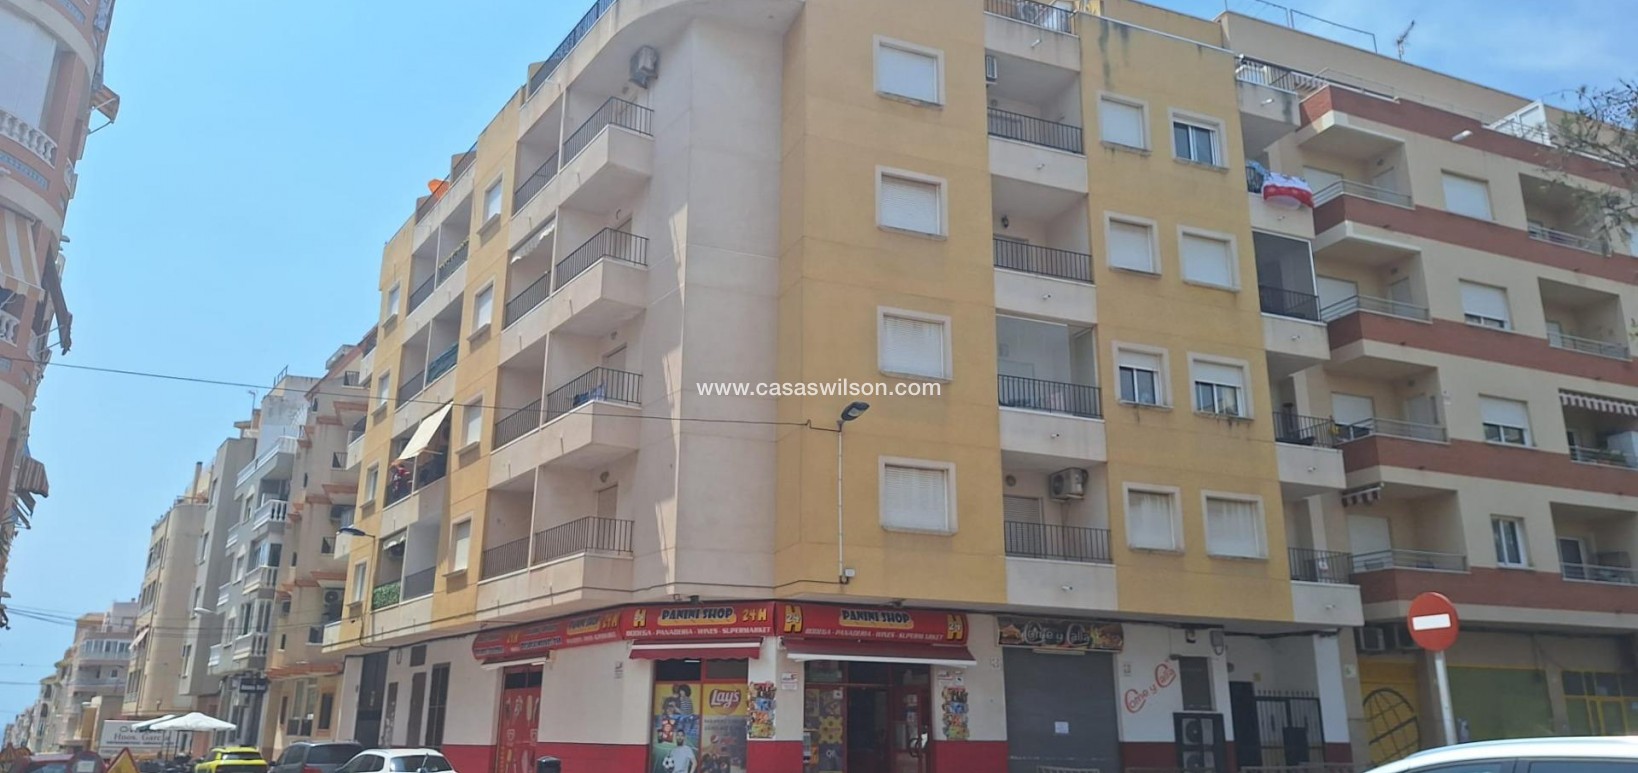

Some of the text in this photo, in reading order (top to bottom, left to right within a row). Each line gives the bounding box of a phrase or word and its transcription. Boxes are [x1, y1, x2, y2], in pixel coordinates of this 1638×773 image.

[661, 609, 700, 620] PANINI
[702, 608, 733, 619] SHOP
[841, 610, 909, 623] PANINI SHOP
